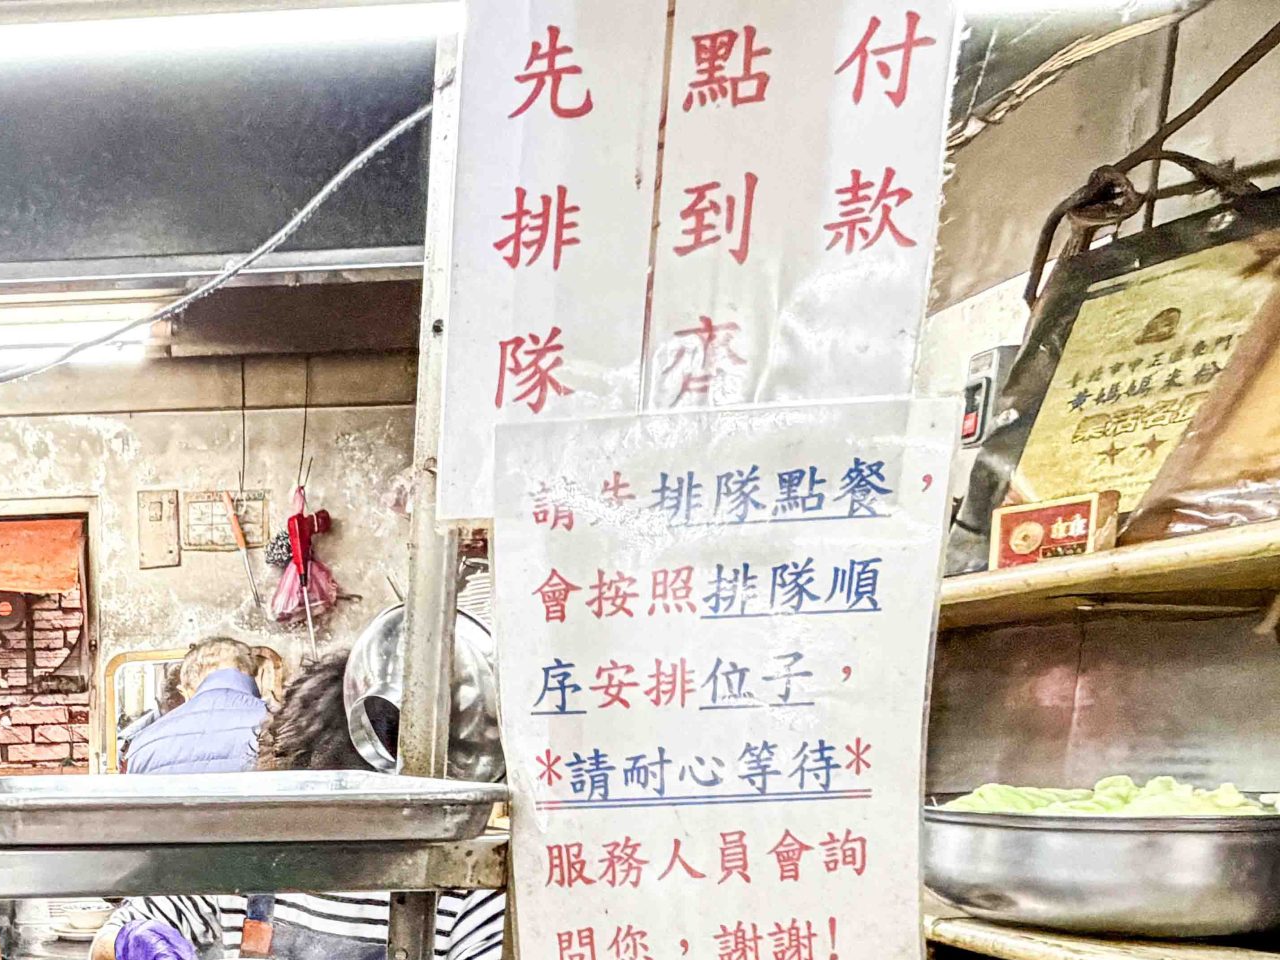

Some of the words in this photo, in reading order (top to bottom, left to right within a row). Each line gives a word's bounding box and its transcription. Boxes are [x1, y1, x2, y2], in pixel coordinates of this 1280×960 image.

[823, 10, 937, 254] 付款
[492, 25, 594, 414] 先排隊
[531, 557, 884, 623] 會按照排隊順
[544, 830, 868, 889] 服務人員會詢
